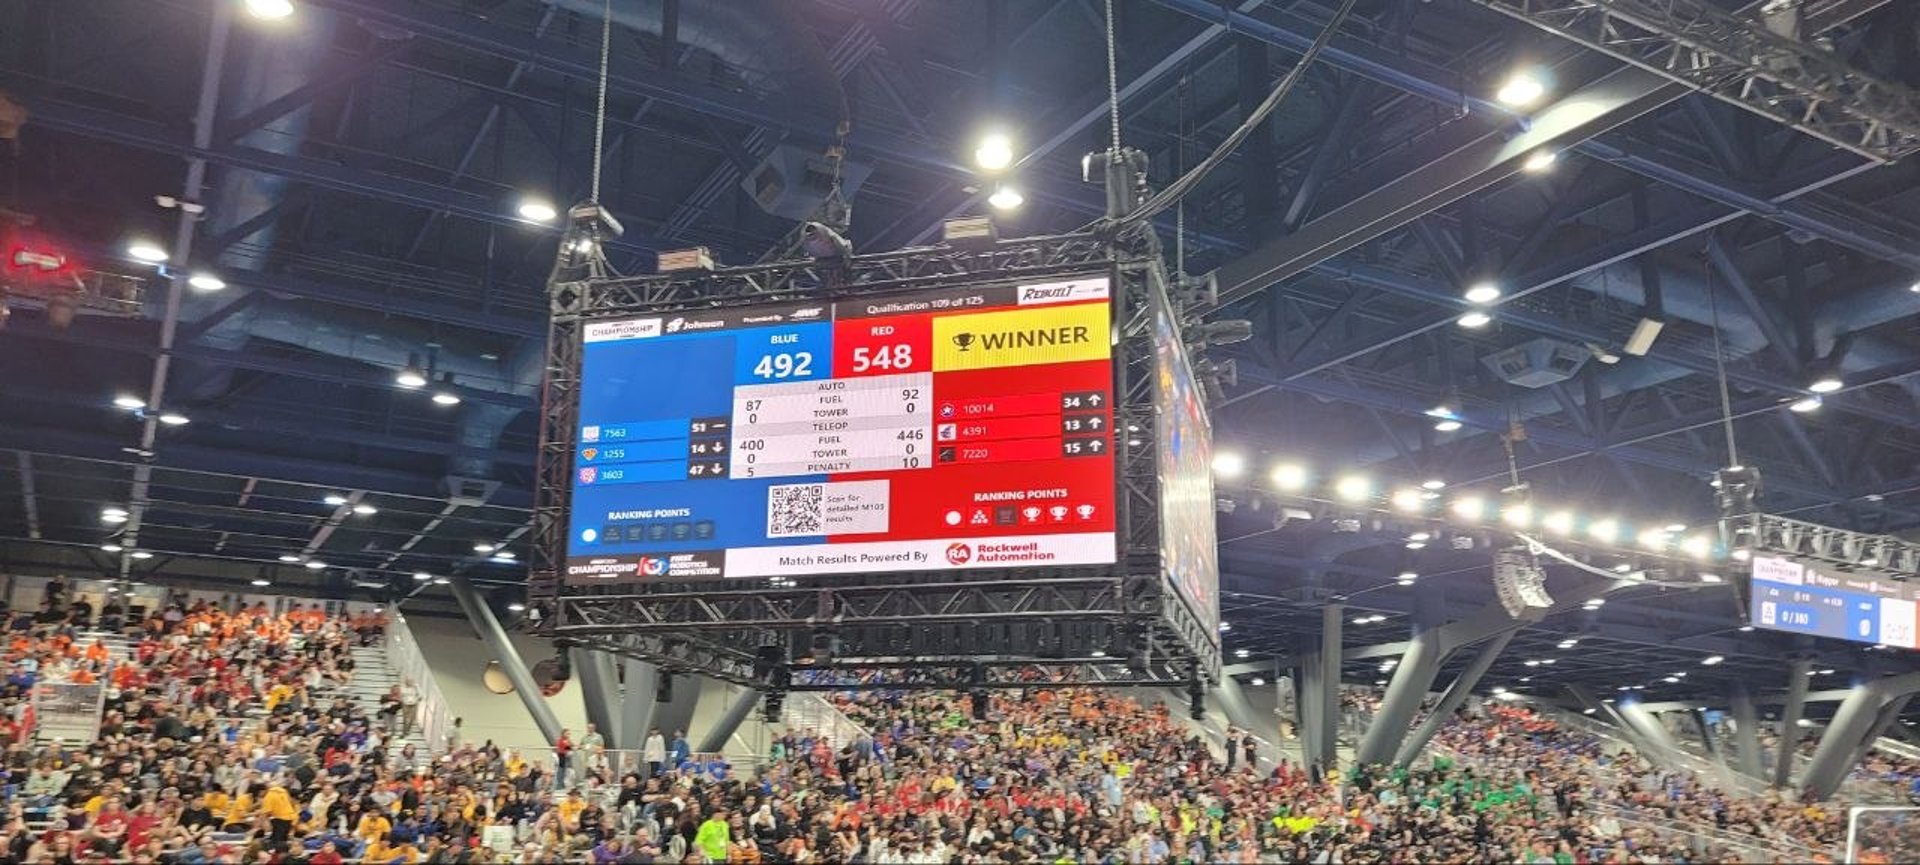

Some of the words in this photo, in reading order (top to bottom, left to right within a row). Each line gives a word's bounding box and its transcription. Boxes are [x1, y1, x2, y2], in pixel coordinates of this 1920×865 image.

[1022, 284, 1076, 301] REBUILT
[867, 300, 928, 314] Qualification
[931, 298, 950, 308] 109
[951, 297, 963, 307] of
[965, 295, 985, 305] 125
[592, 324, 653, 336] CHAMPIONSHIP
[683, 319, 724, 330] Johnson
[871, 326, 894, 336] RED
[771, 334, 799, 344] BLUE
[981, 326, 1089, 350] WINNER
[853, 344, 912, 372] 548
[753, 352, 812, 379] 492
[818, 382, 845, 391] AUTO
[819, 395, 843, 404] FUEL
[902, 389, 919, 401] 92
[746, 400, 762, 412] 87
[906, 403, 915, 413] 0
[963, 403, 994, 413] 10014
[1064, 397, 1080, 408] 34
[749, 413, 757, 424] 0
[813, 408, 848, 418] TOWER
[692, 423, 706, 433] 51
[813, 422, 848, 431] TELEOP
[962, 426, 987, 436] 4391
[1064, 420, 1080, 431] 13
[818, 436, 842, 445] FUEL
[897, 429, 924, 441] 446
[691, 444, 706, 454] 14
[739, 439, 765, 451] 400
[906, 444, 915, 455] 0
[1065, 443, 1080, 453] 15
[747, 453, 756, 464] 0
[812, 449, 847, 458] TOWER
[963, 449, 988, 459] 7220
[807, 462, 851, 472] PENALTY
[902, 457, 919, 468] 10
[689, 465, 704, 475] 47
[747, 467, 754, 477] 5
[974, 490, 1025, 502] RANKING
[1027, 488, 1068, 499] POINTS
[608, 510, 652, 520] RANKING
[654, 508, 690, 518] POINTS
[826, 515, 853, 523] results
[978, 543, 1037, 553] Rockwell
[779, 556, 813, 566] Match
[817, 554, 857, 565] Results
[860, 551, 910, 563] Powered
[914, 551, 928, 563] By
[977, 551, 1055, 562] Automation
[569, 563, 638, 575] CHAMPIONSHIP
